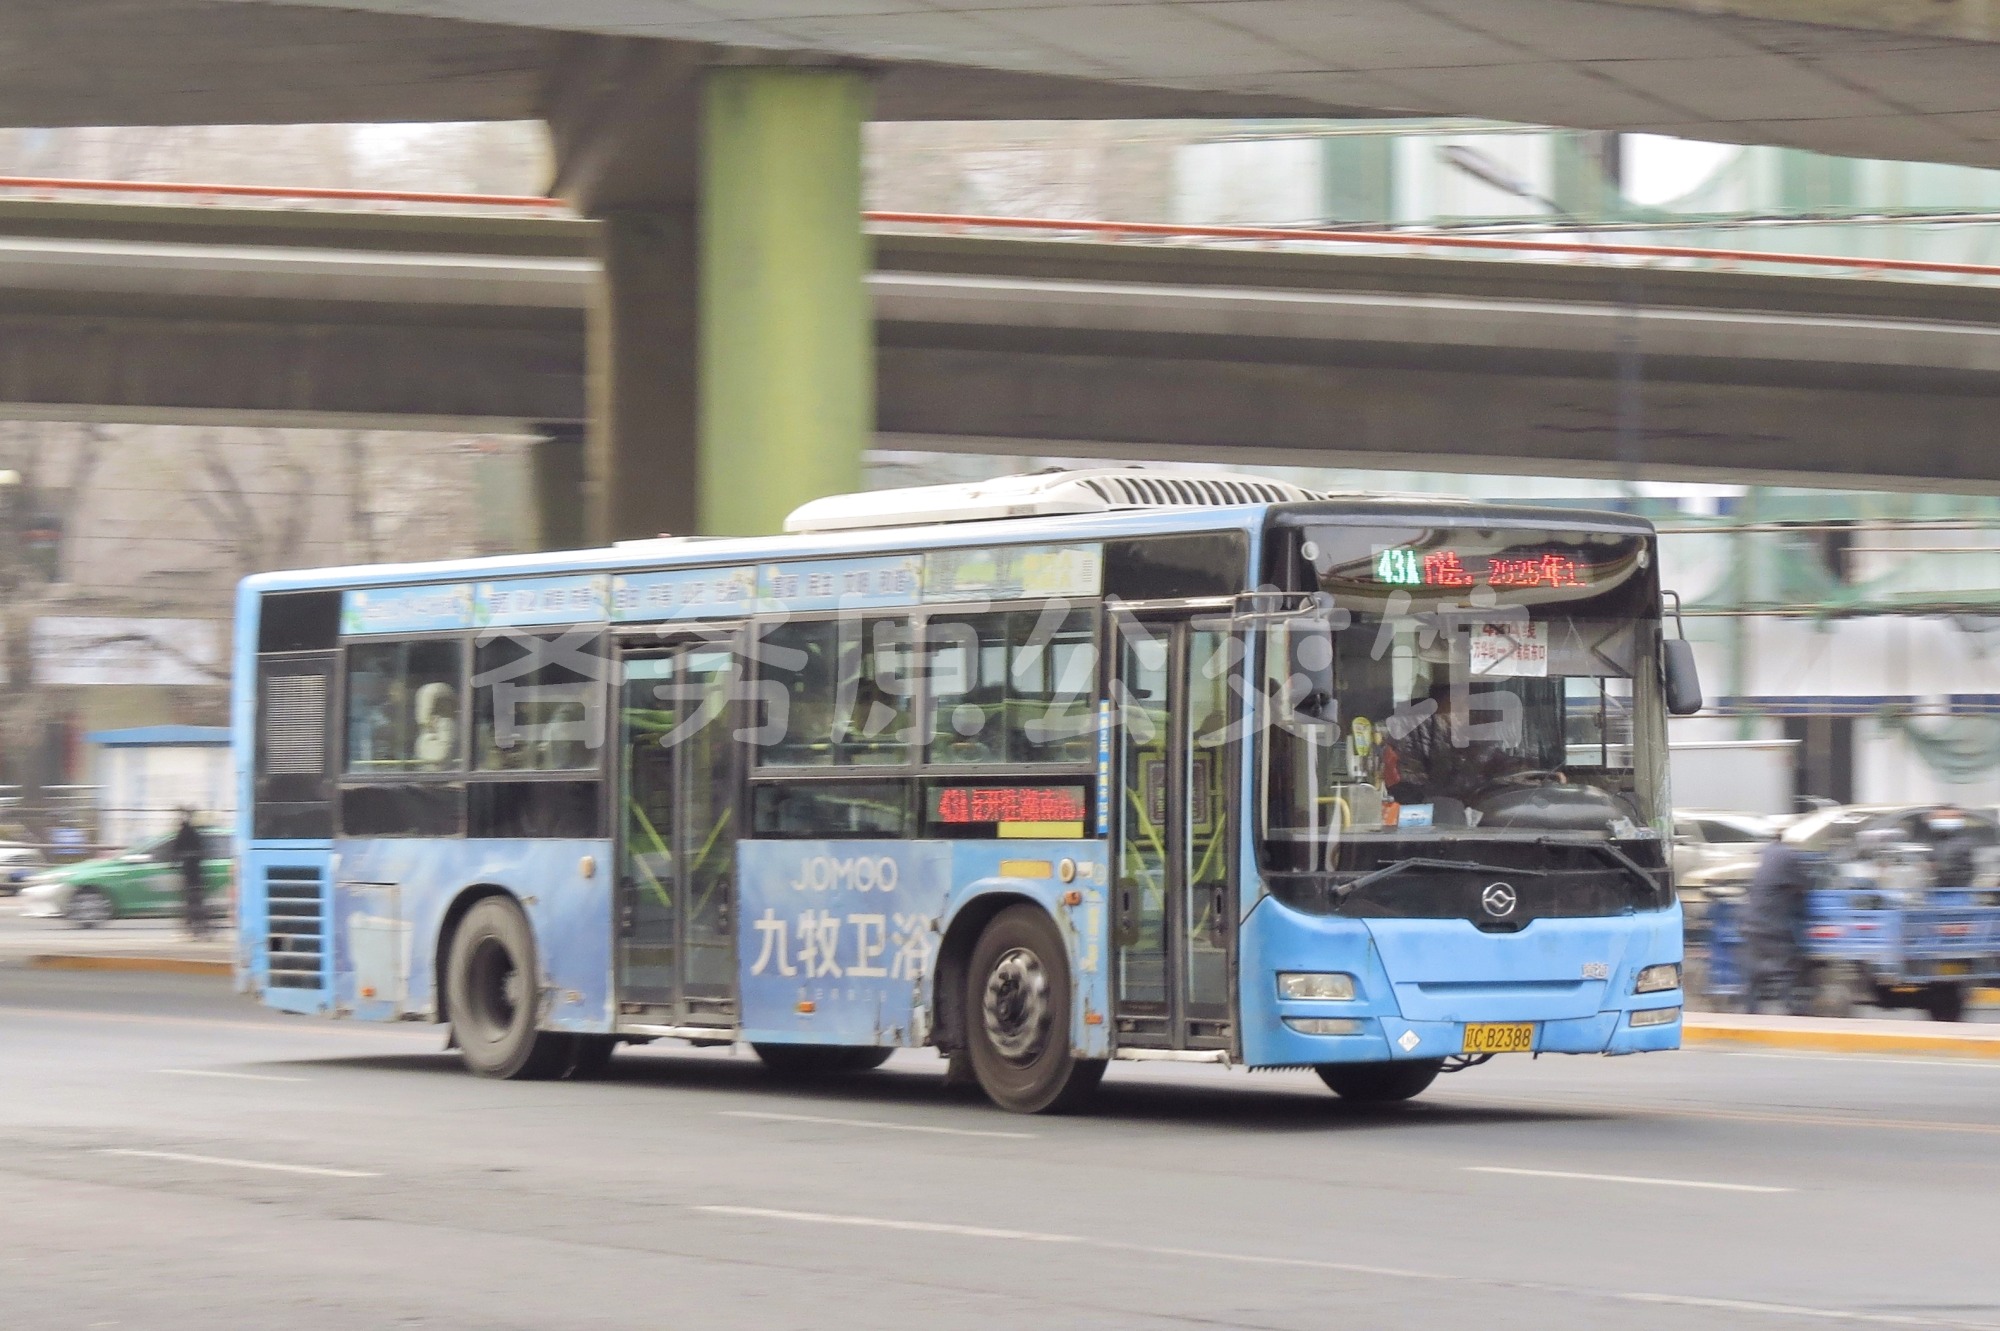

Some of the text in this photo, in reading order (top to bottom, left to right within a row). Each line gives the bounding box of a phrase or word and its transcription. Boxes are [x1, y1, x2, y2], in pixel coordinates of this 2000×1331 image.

[791, 856, 899, 892] JOMOO
[750, 908, 933, 981] 九牧卫浴
